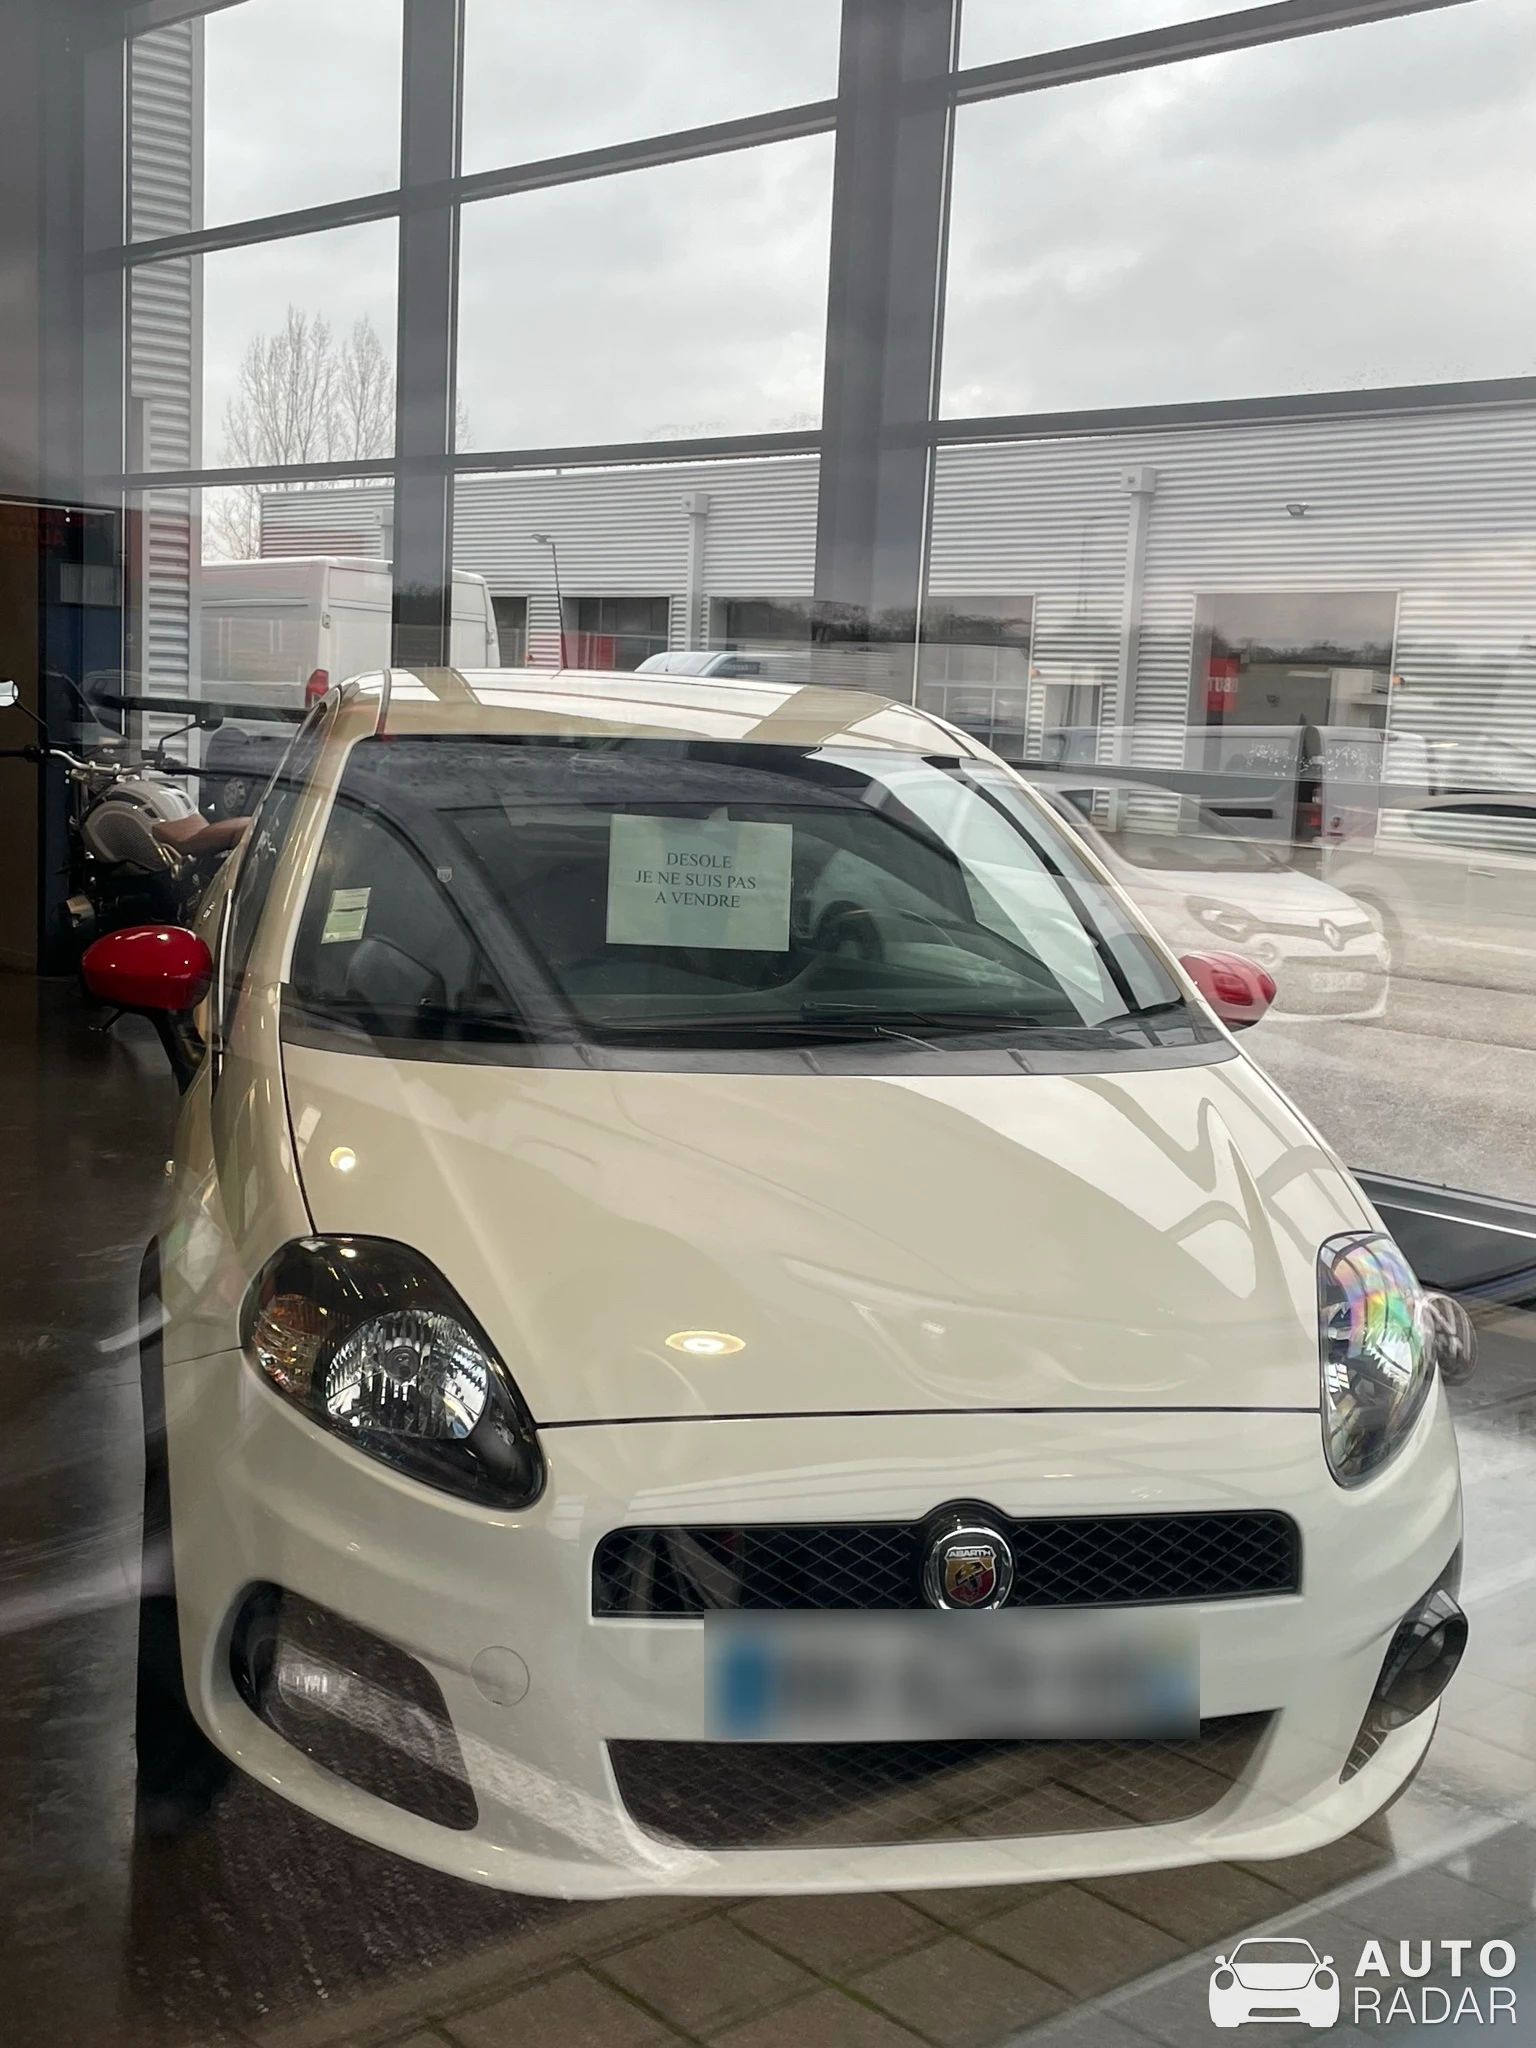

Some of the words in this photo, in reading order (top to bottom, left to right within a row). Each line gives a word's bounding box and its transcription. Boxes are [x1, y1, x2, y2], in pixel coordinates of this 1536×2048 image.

[667, 853, 732, 869] DESOLE
[635, 870, 653, 884] JE
[658, 872, 681, 885] NE
[685, 873, 722, 888] SUIS
[727, 876, 756, 889] PAS
[654, 892, 667, 904] A
[671, 892, 740, 908] VENDRE
[948, 1548, 991, 1558] ABARTH
